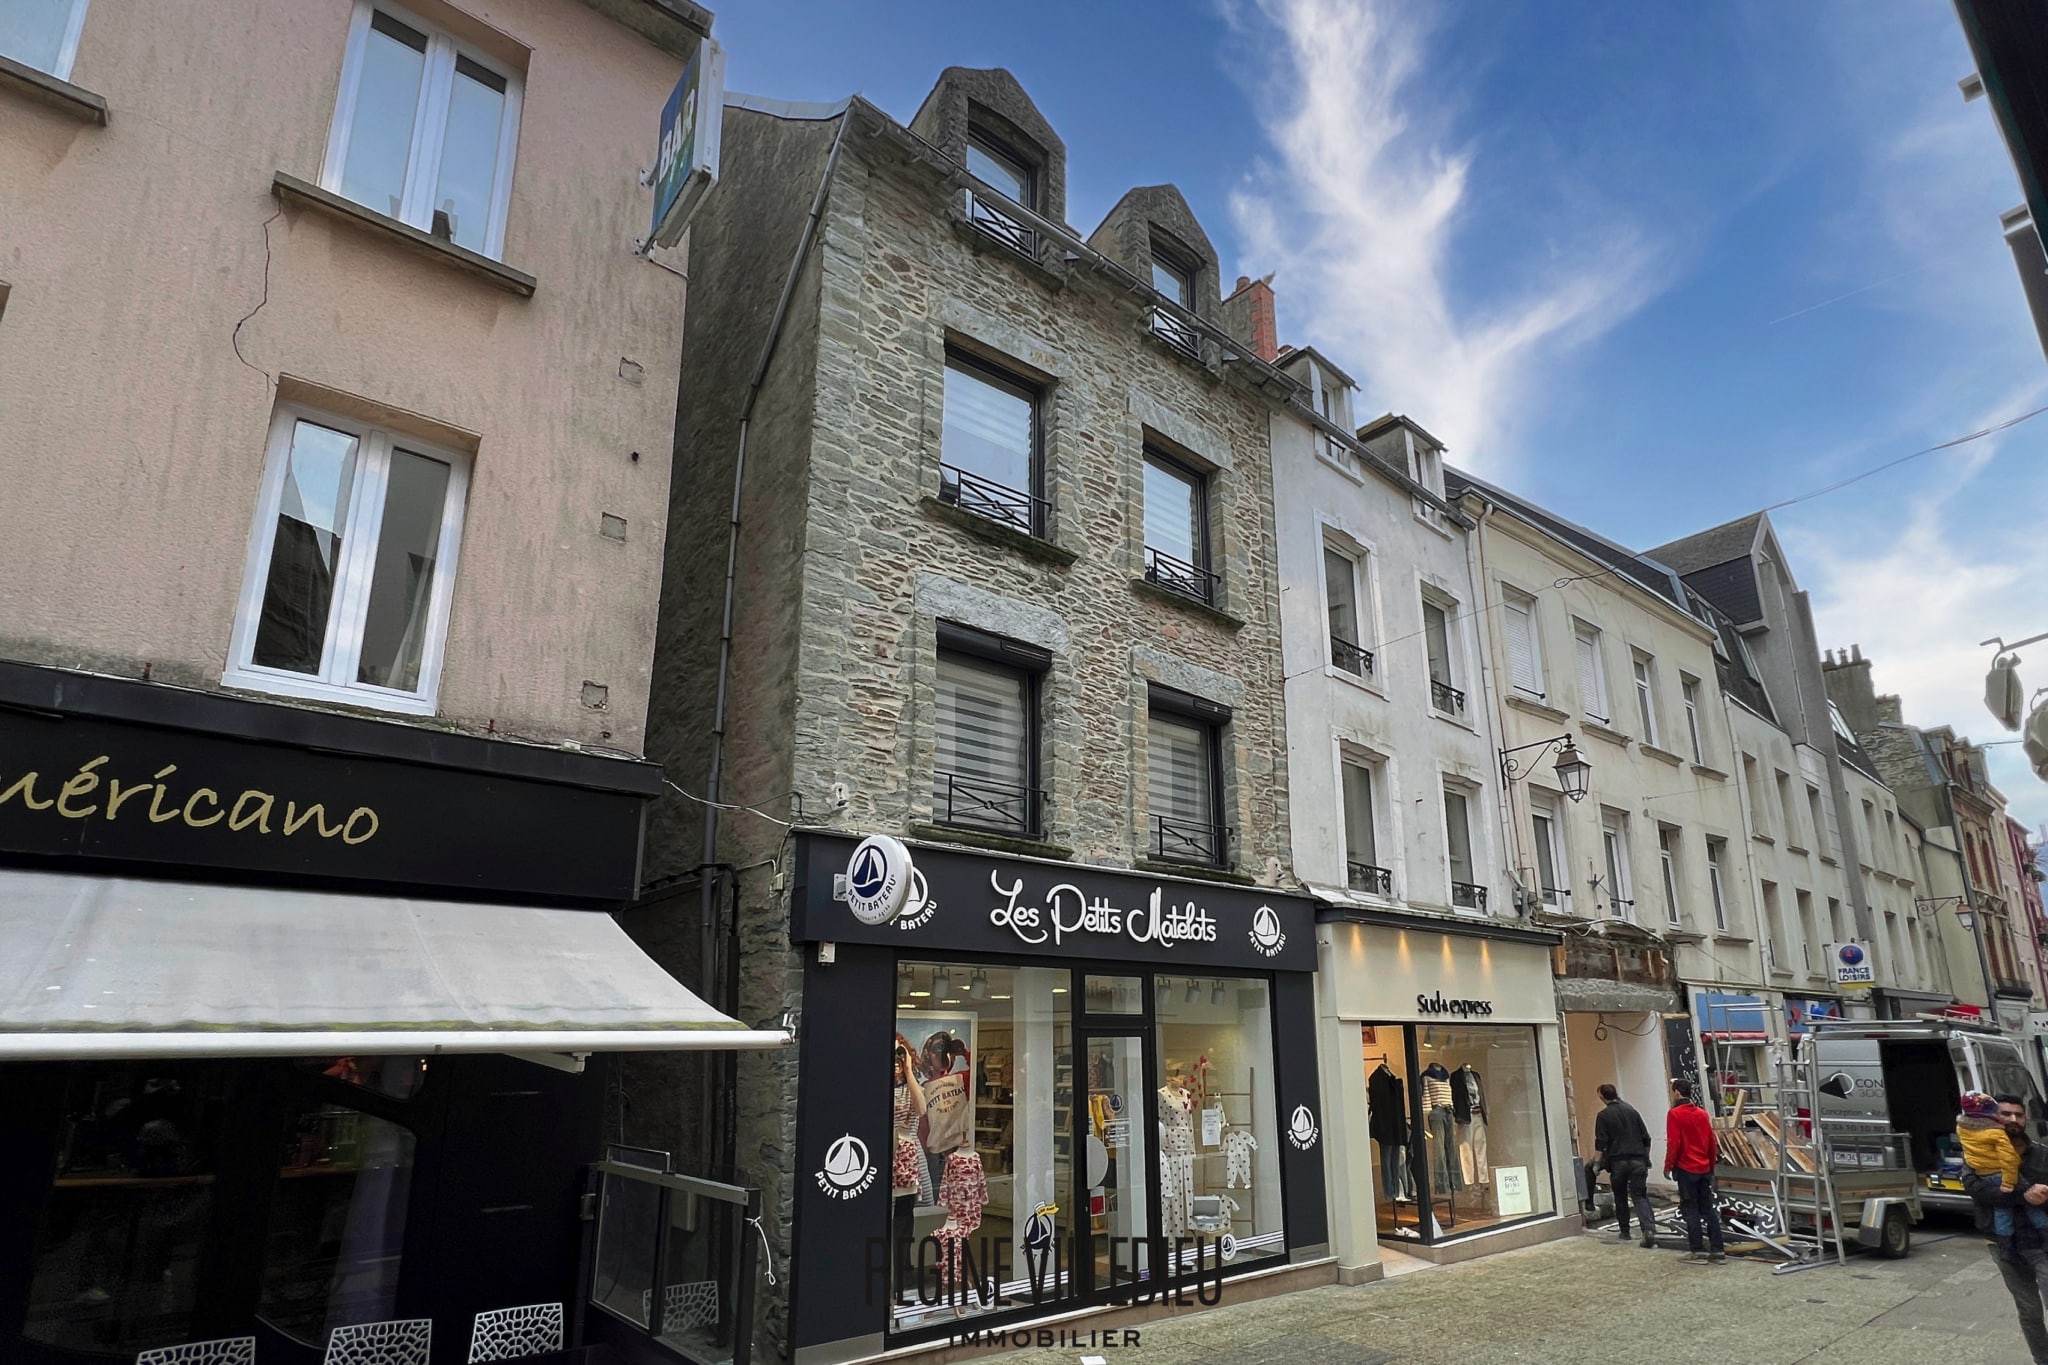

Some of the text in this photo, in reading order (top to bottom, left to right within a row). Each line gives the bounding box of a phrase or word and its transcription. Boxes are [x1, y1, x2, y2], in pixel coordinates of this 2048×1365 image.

[659, 89, 695, 184] BAR
[848, 879, 897, 911] PETIT BATEAU
[990, 869, 1217, 947] Les Petits Matelots
[900, 900, 937, 930] BATEAU
[1248, 931, 1287, 957] PETIT BATEAU
[927, 1095, 942, 1108] ETIT
[815, 1166, 878, 1200] PETIT BATEAU
